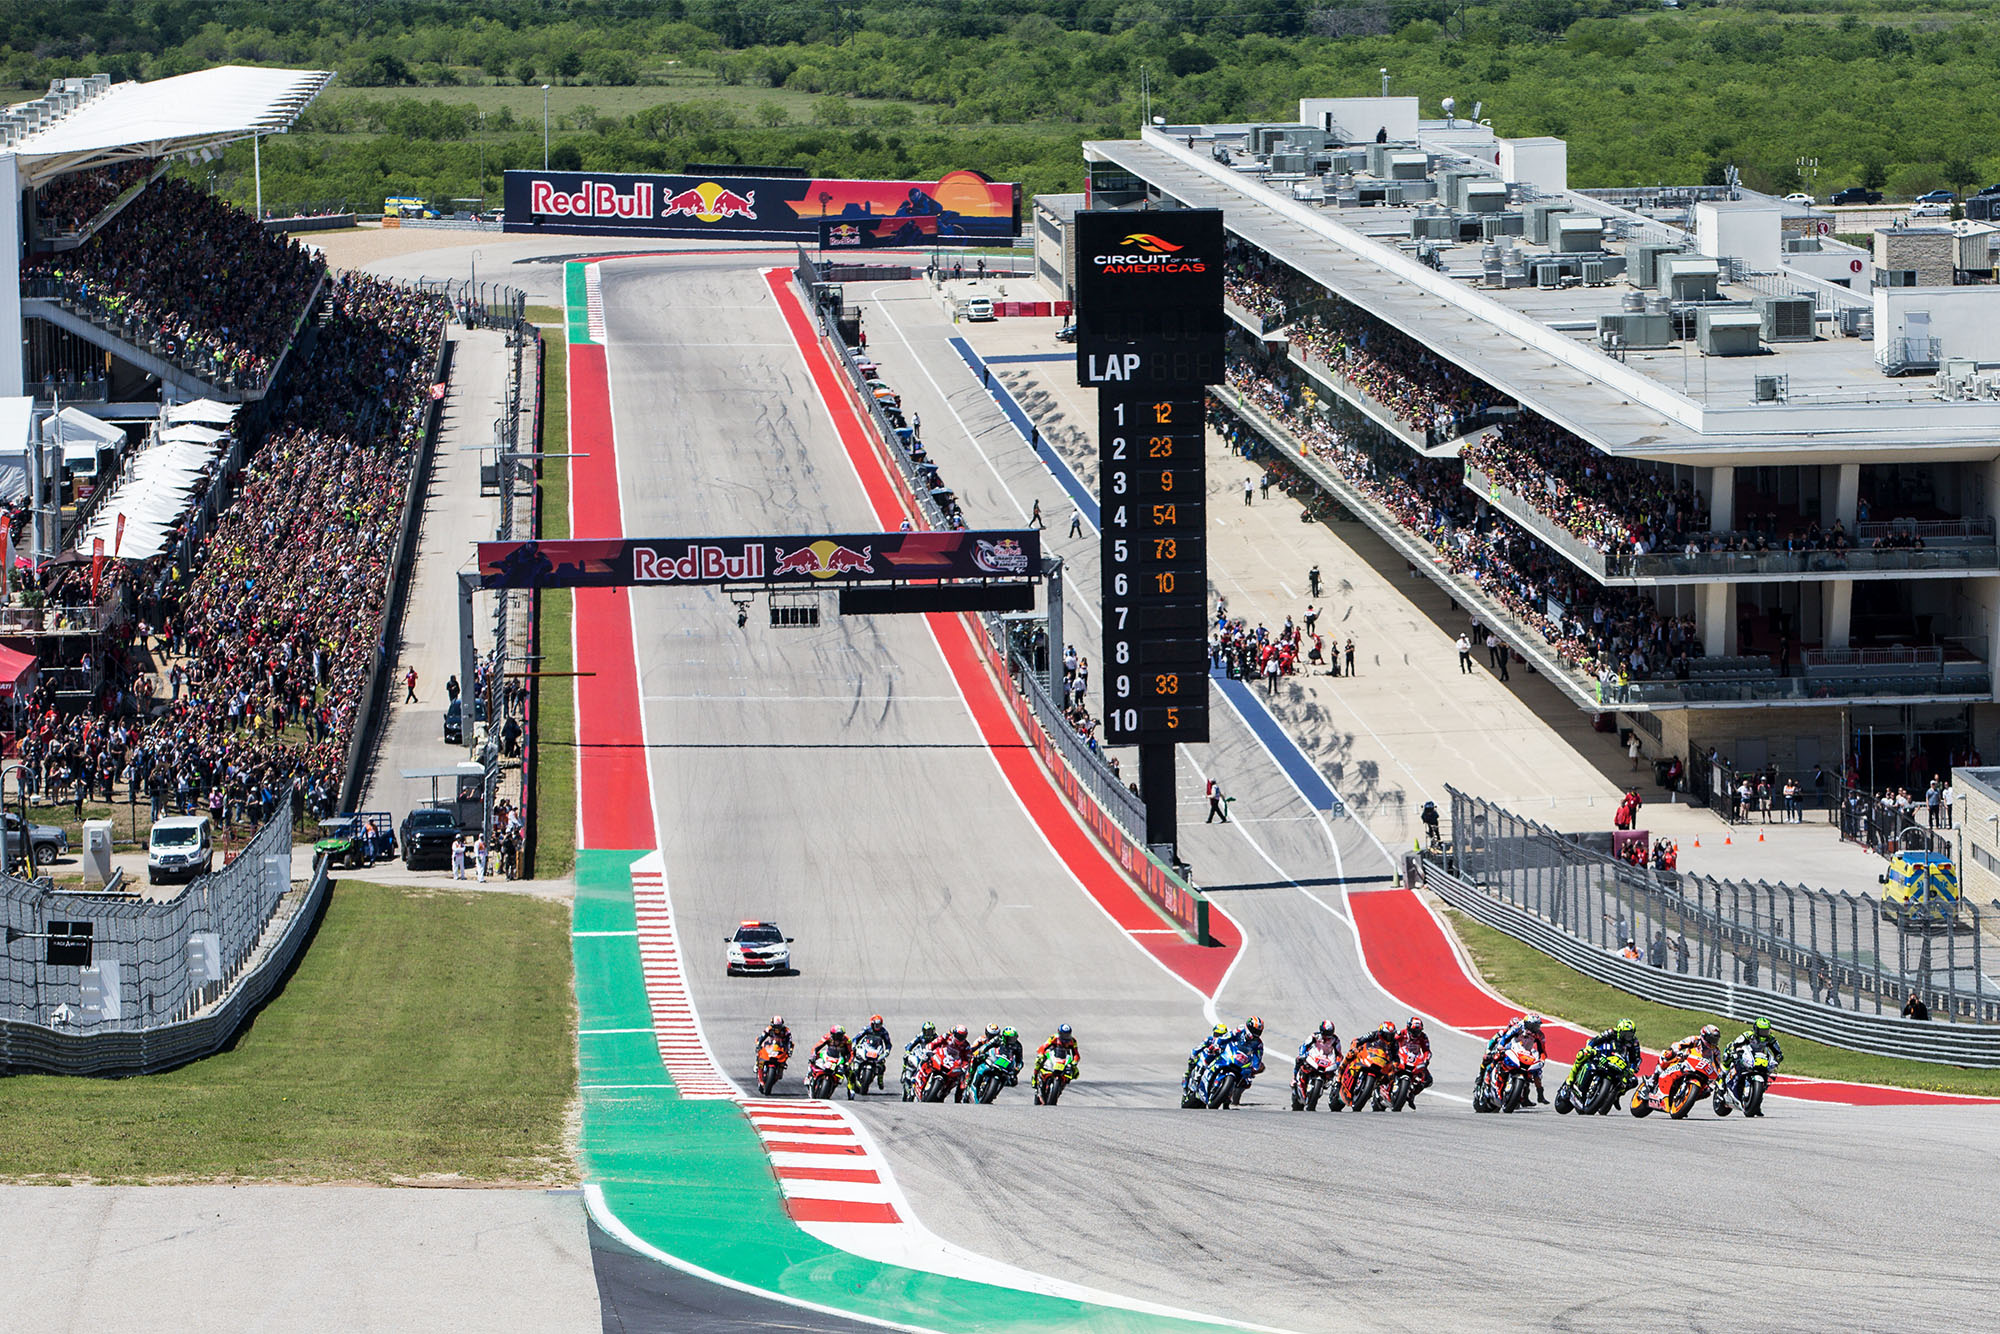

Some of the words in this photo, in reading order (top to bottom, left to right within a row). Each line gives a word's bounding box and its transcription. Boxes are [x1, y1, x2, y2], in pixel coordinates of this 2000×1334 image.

[532, 181, 592, 216] Red
[594, 183, 654, 219] Bull
[1094, 255, 1171, 265] CIRCUIT
[1102, 263, 1206, 273] AMERICAS
[1088, 354, 1141, 382] LAP
[1113, 403, 1124, 426] 1
[1152, 403, 1172, 424] 12
[1112, 437, 1127, 460] 2
[1149, 437, 1173, 458] 23
[1113, 471, 1127, 494] 3
[1161, 471, 1173, 491] 9
[1113, 505, 1128, 528] 4
[1153, 505, 1177, 525] 54
[633, 545, 699, 580] Red
[701, 544, 765, 579] Bull
[1114, 539, 1128, 562] 5
[1153, 539, 1177, 559] 73
[1114, 573, 1128, 596] 6
[1155, 572, 1175, 593] 10
[1115, 607, 1129, 630] 7
[1116, 641, 1129, 664] 8
[1116, 675, 1130, 698] 9
[1155, 674, 1178, 695] 33
[1110, 708, 1137, 732] 10
[1167, 708, 1179, 729] 5
[1606, 1055, 1628, 1070] 46
[1695, 1060, 1714, 1076] 93
